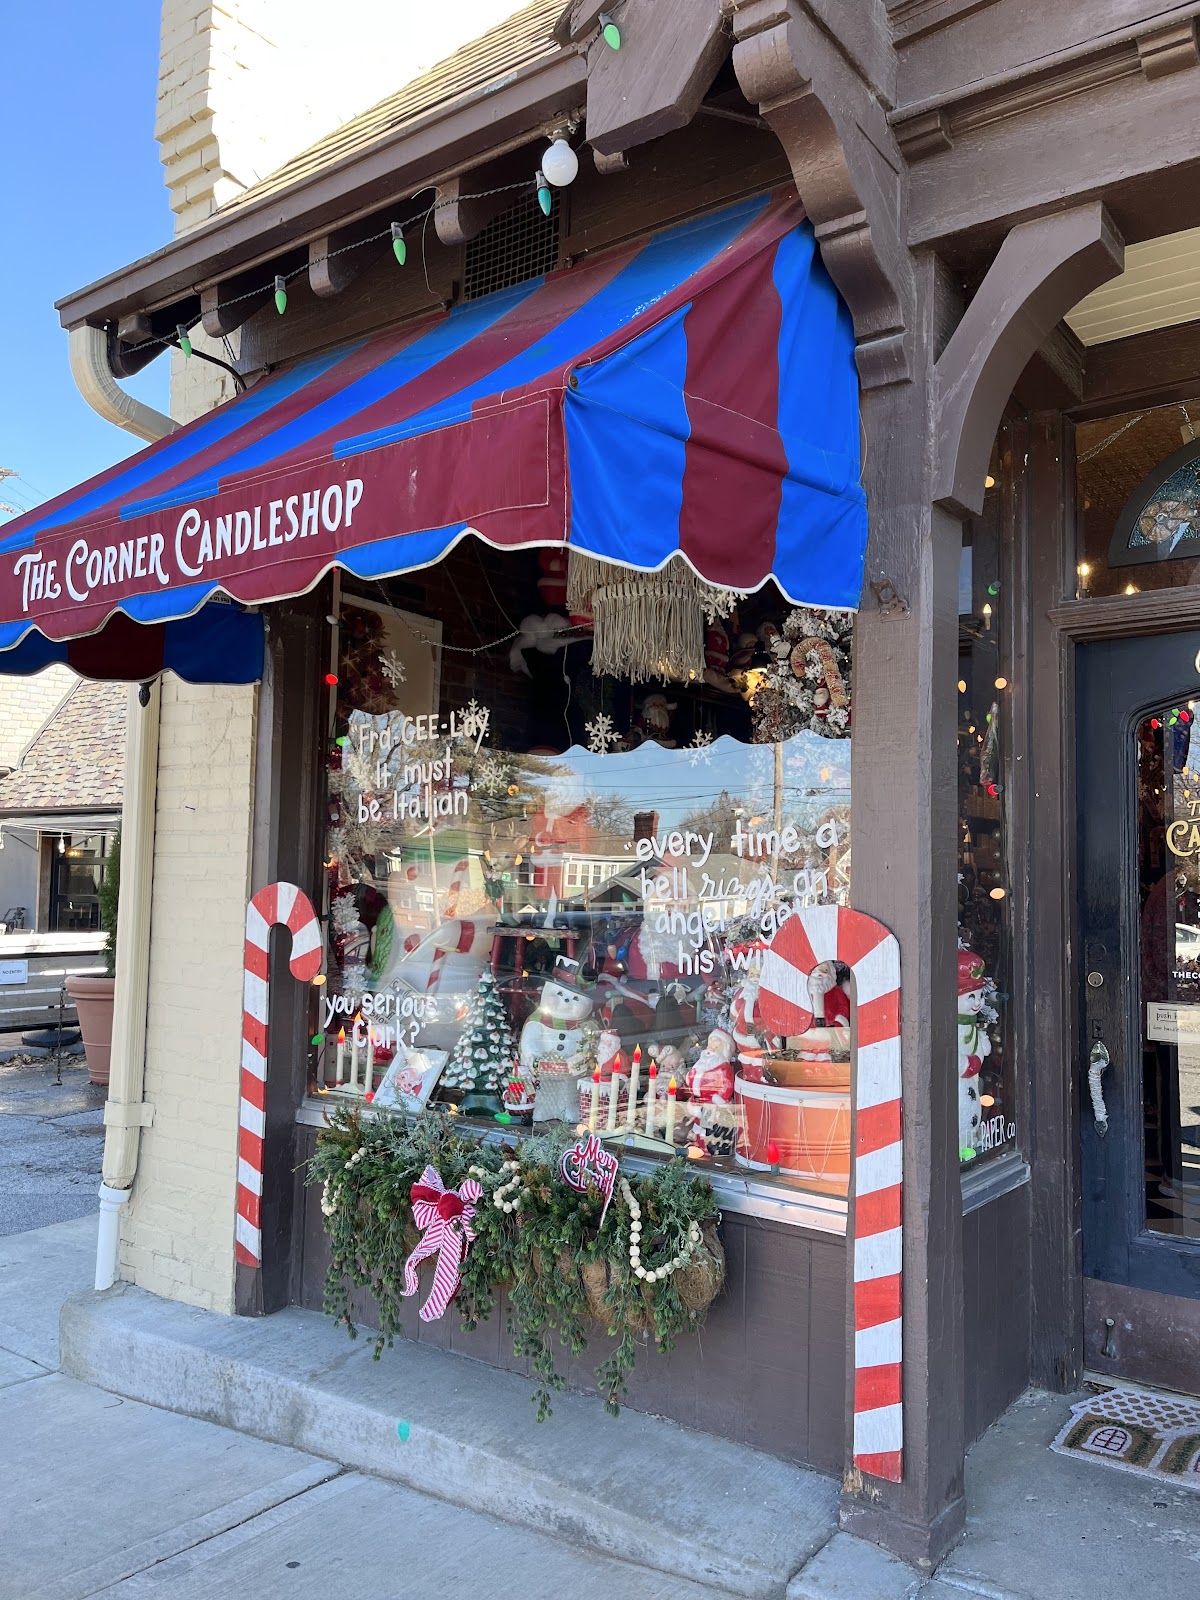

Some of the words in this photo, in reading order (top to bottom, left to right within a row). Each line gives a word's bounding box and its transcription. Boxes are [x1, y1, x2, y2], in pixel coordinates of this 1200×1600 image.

[14, 550, 61, 612] THE
[66, 532, 170, 602] CORNER
[175, 478, 365, 577] CANDLESHOP
[404, 746, 454, 785] must
[357, 793, 382, 824] be
[1187, 800, 1200, 817] T
[730, 819, 800, 858] time
[815, 818, 839, 849] a
[640, 866, 688, 900] bell
[699, 867, 784, 920] rings
[793, 868, 829, 898] an
[655, 900, 725, 949] angel
[678, 940, 714, 976] his
[1172, 970, 1200, 980] THEC
[361, 986, 438, 1018] serious
[980, 1114, 1006, 1153] PAPER
